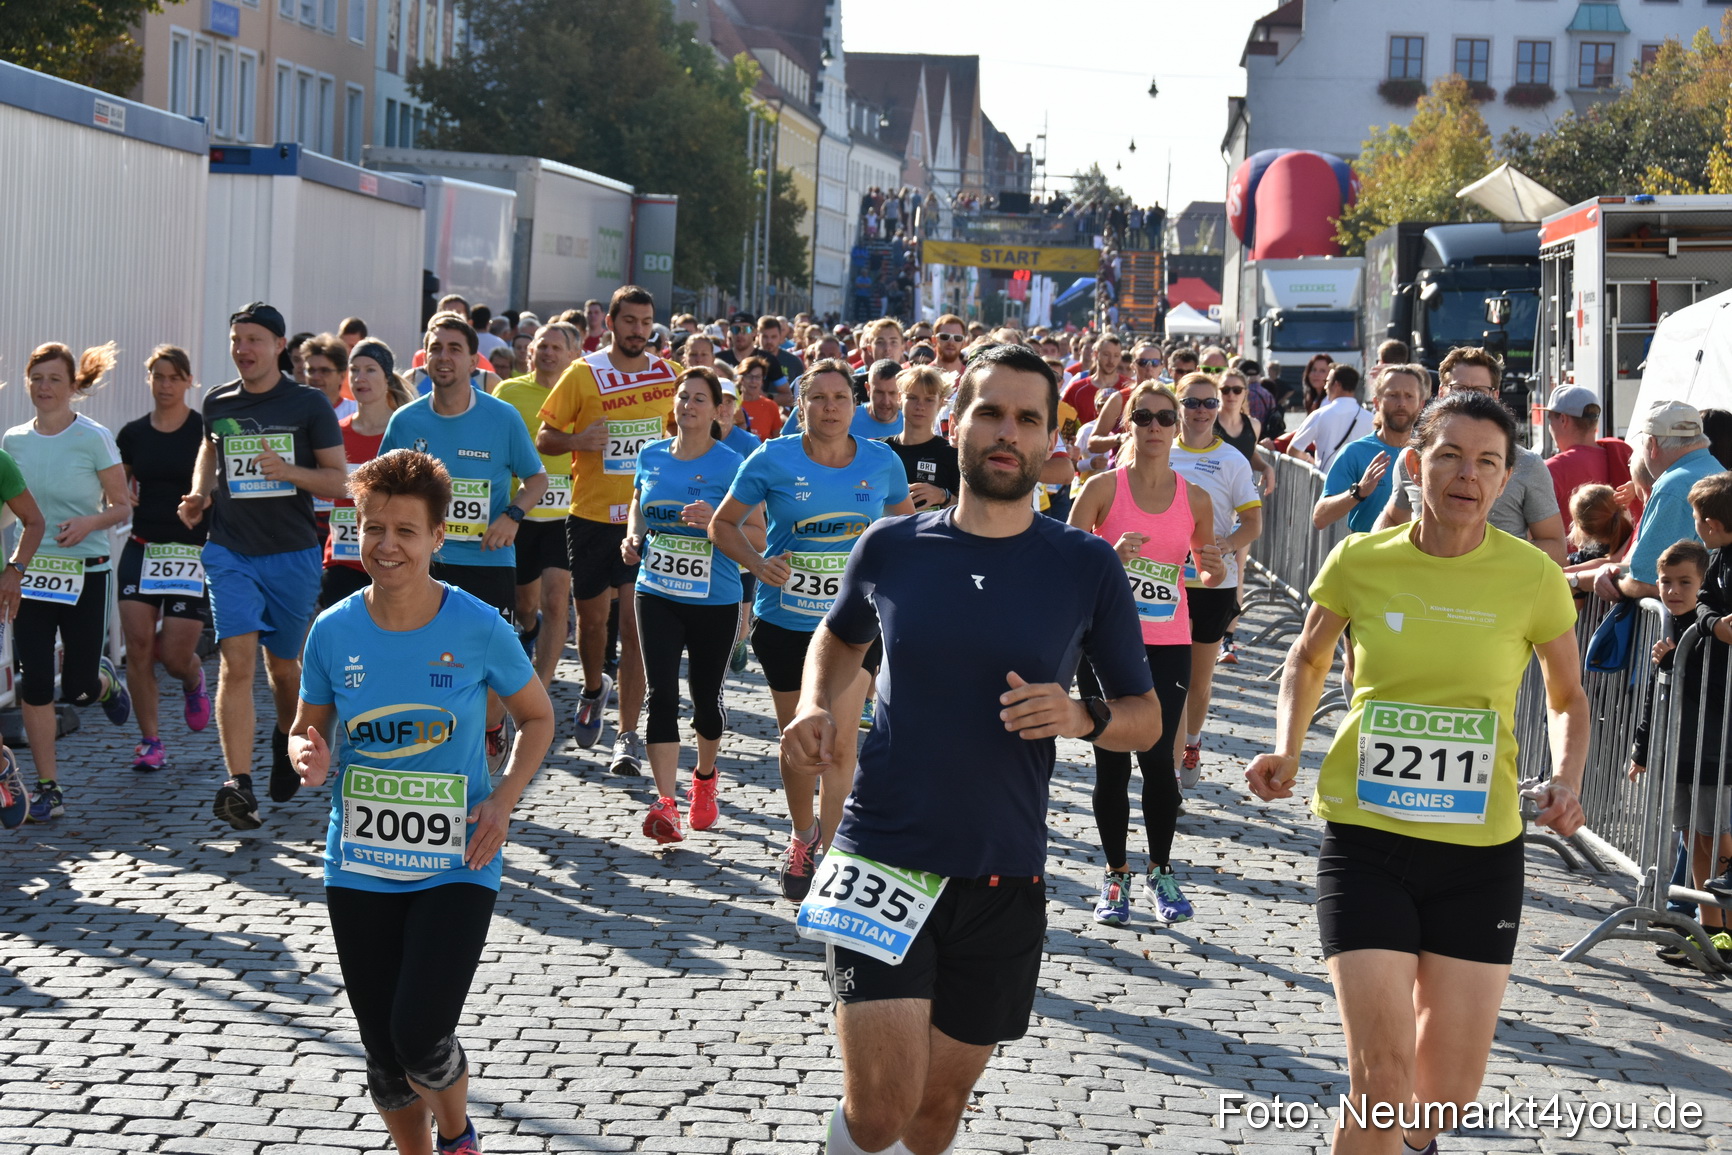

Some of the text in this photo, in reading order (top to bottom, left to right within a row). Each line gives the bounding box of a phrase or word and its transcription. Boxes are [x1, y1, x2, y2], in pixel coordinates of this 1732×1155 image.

[980, 248, 1041, 265] START
[602, 394, 638, 412] MAX
[608, 420, 657, 435] BOCK
[458, 449, 490, 459] BOCK
[610, 438, 655, 457] 240
[619, 461, 637, 469] JOV
[919, 462, 935, 472] BRL
[239, 480, 281, 491] ROBERT
[453, 482, 485, 496] CK
[655, 535, 706, 554] BOCK
[150, 562, 198, 578] 2677
[650, 552, 704, 578] 2366
[1124, 559, 1174, 581] OCK
[21, 573, 74, 593] 2801
[791, 573, 843, 596] 236
[1128, 576, 1172, 601] 788
[797, 599, 835, 611] MARG
[1430, 605, 1454, 613] Kliniken
[1447, 613, 1476, 622] Neumarkt
[429, 673, 453, 688] TUM
[344, 720, 455, 745] LAUF10!
[1371, 706, 1485, 740] BOCK
[1372, 742, 1475, 783] 2211
[352, 772, 455, 803] BOCK
[1387, 790, 1455, 809] AGNES
[355, 805, 451, 846] 2009
[353, 847, 451, 869] STEPHANIE
[818, 863, 916, 923] 2335
[806, 907, 897, 946] SEBASTIAN
